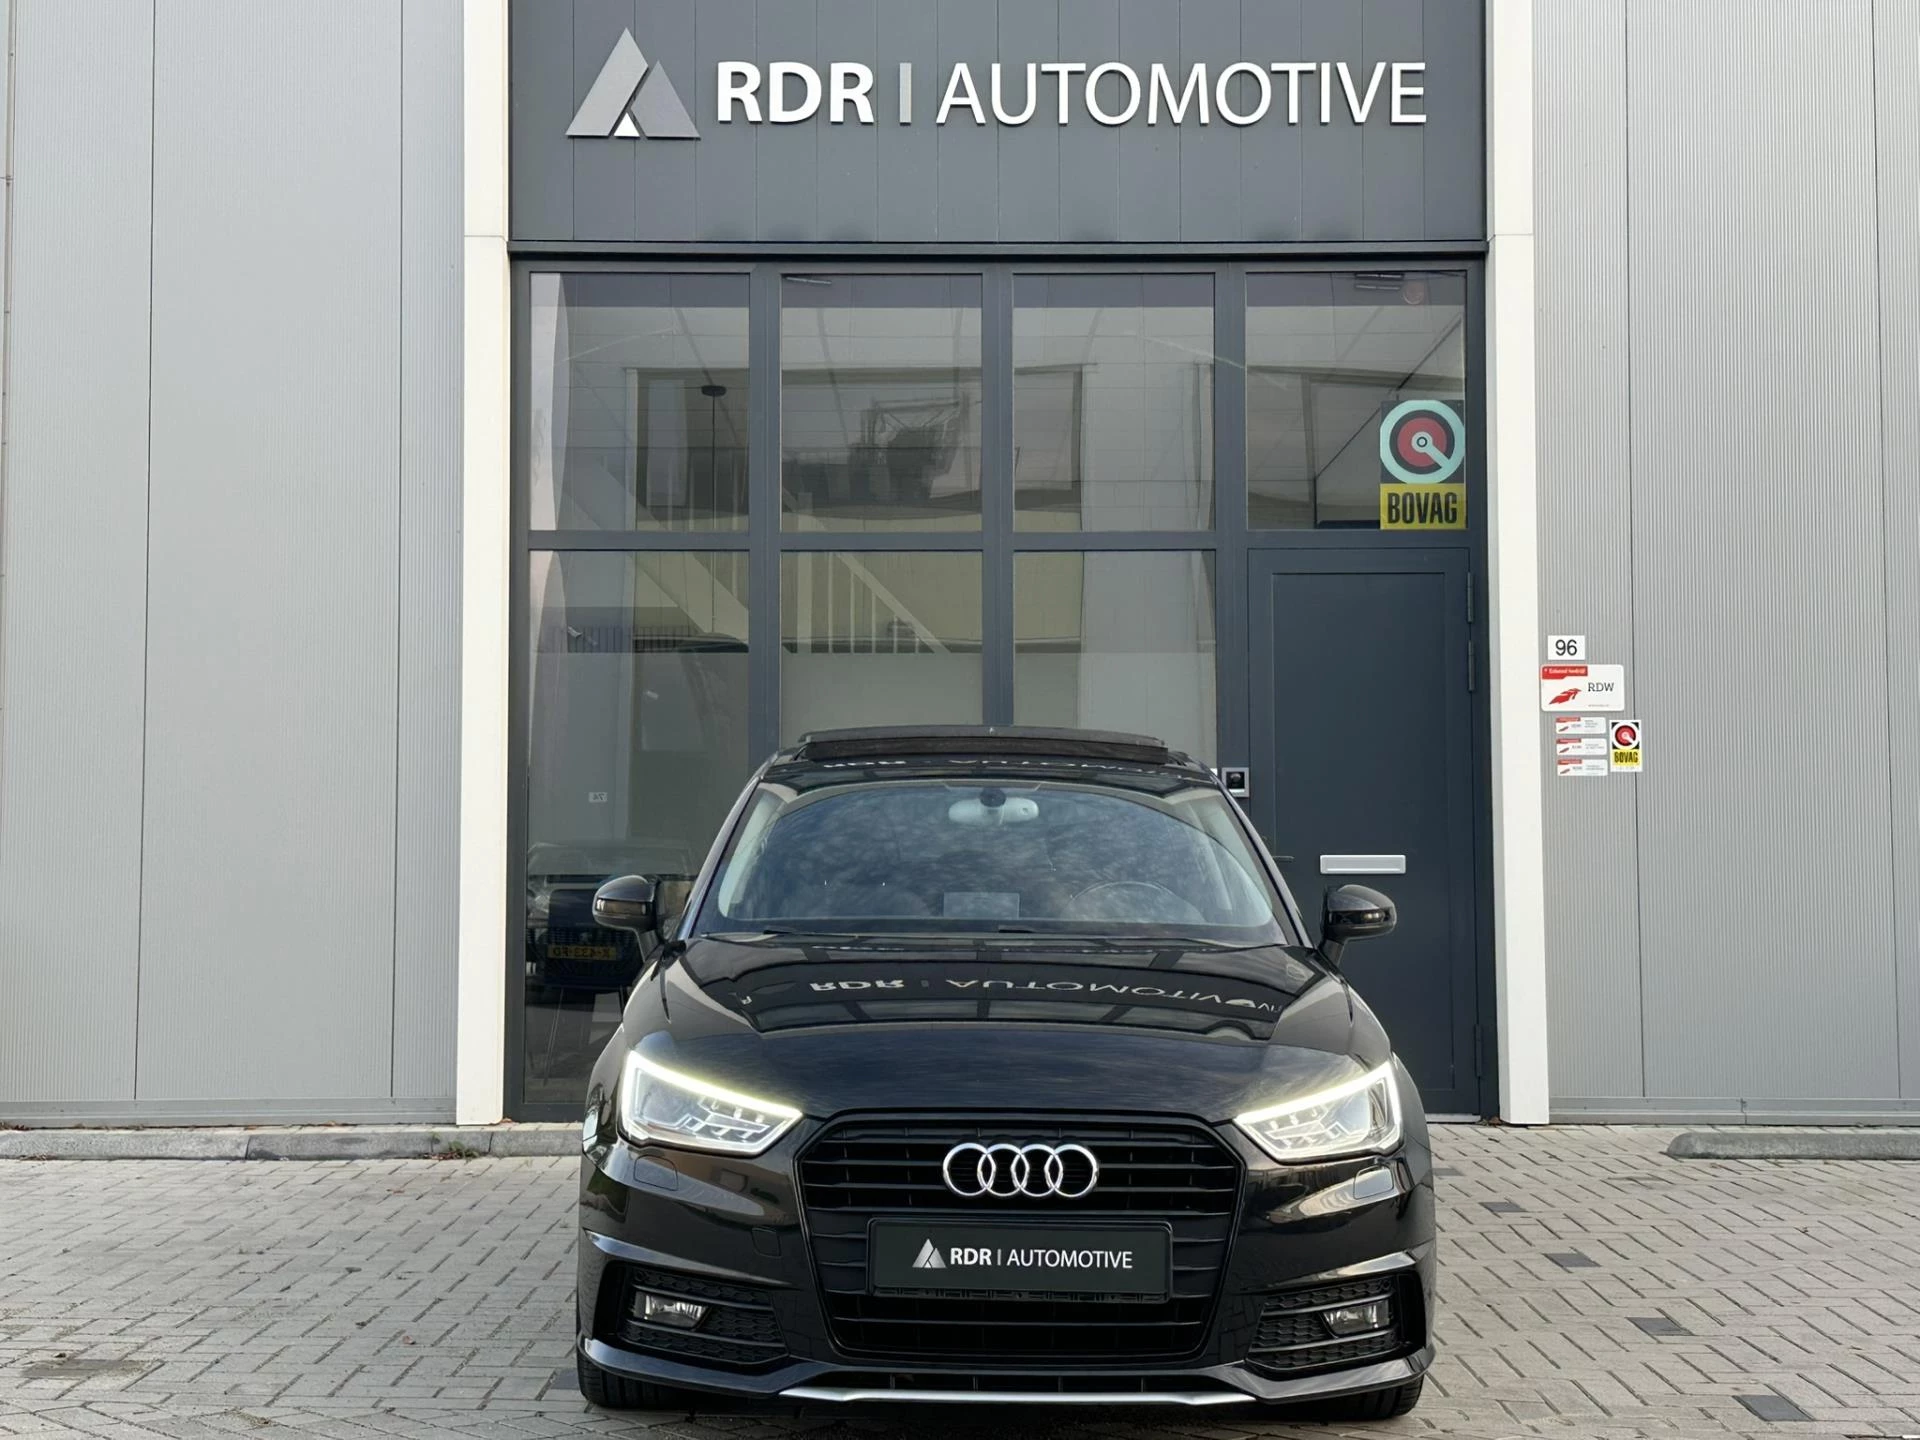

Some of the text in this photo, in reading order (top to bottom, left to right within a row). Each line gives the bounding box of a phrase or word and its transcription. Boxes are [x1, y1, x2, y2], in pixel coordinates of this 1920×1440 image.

[718, 61, 874, 123] RDR
[936, 61, 1427, 125] AUTOMOTIVE
[1387, 492, 1458, 524] BOVAG
[1555, 639, 1578, 656] 96
[1587, 682, 1615, 692] RDW
[1614, 751, 1638, 763] BOVAG
[950, 1247, 992, 1266] RDR
[1006, 1248, 1133, 1269] AUTOMOTIVE
